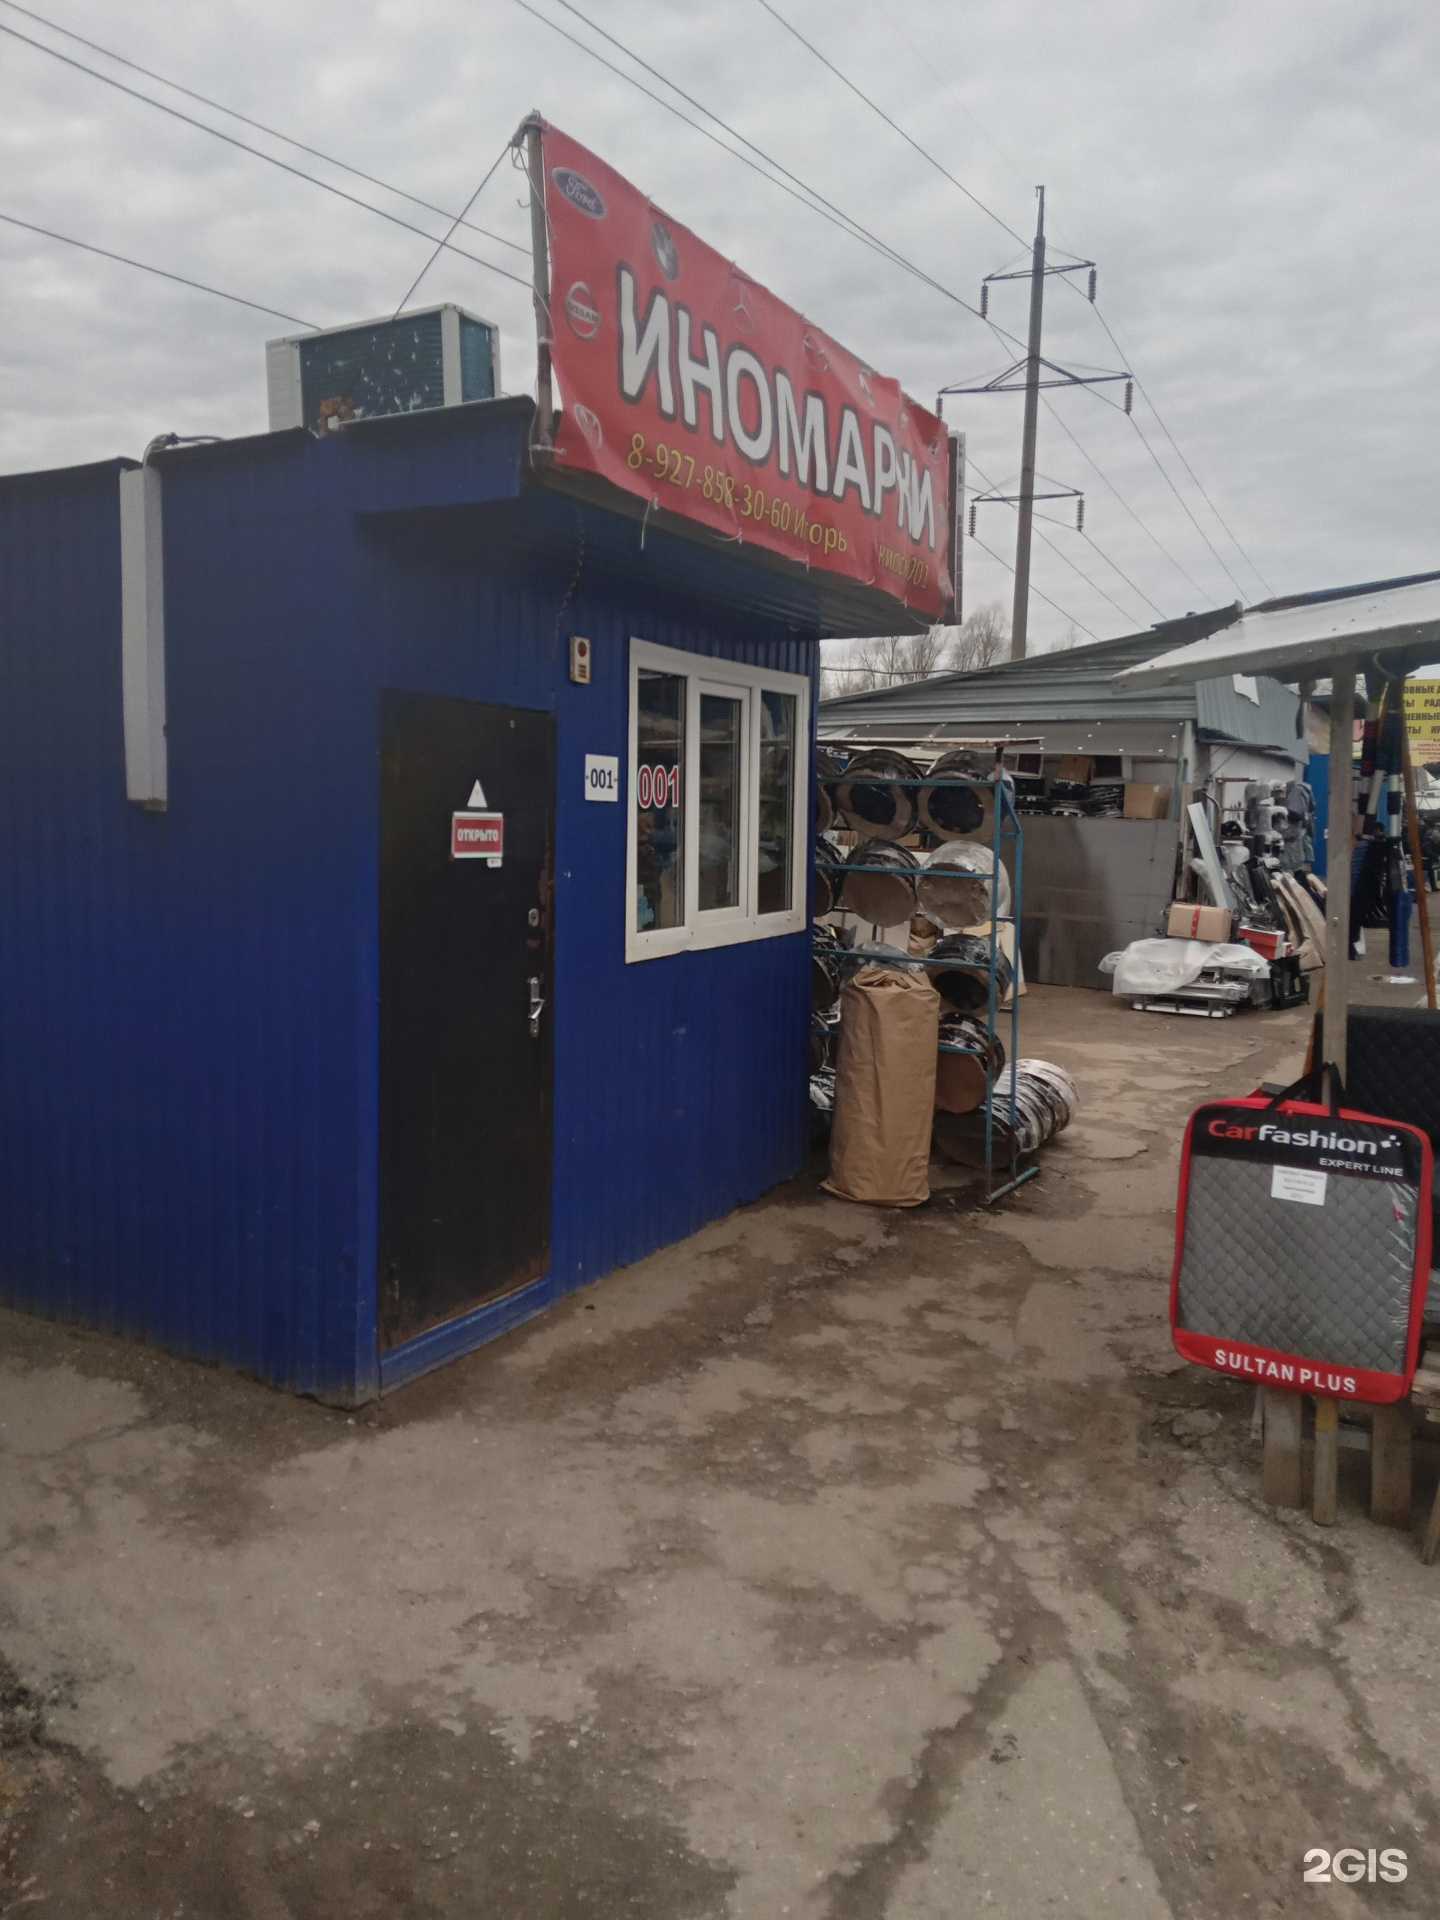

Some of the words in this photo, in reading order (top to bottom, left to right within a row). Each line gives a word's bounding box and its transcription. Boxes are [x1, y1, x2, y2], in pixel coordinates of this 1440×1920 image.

[616, 262, 937, 552] ИНОМАРКИ
[793, 508, 849, 554] Иорь
[590, 767, 614, 790] 001
[637, 764, 679, 809] 001
[457, 827, 499, 842] ОТКРЫТО
[1319, 1157, 1371, 1172] EXPERT
[1372, 1165, 1404, 1177] LINE
[1214, 1349, 1294, 1382] SULTAN
[1299, 1367, 1357, 1393] PLUS
